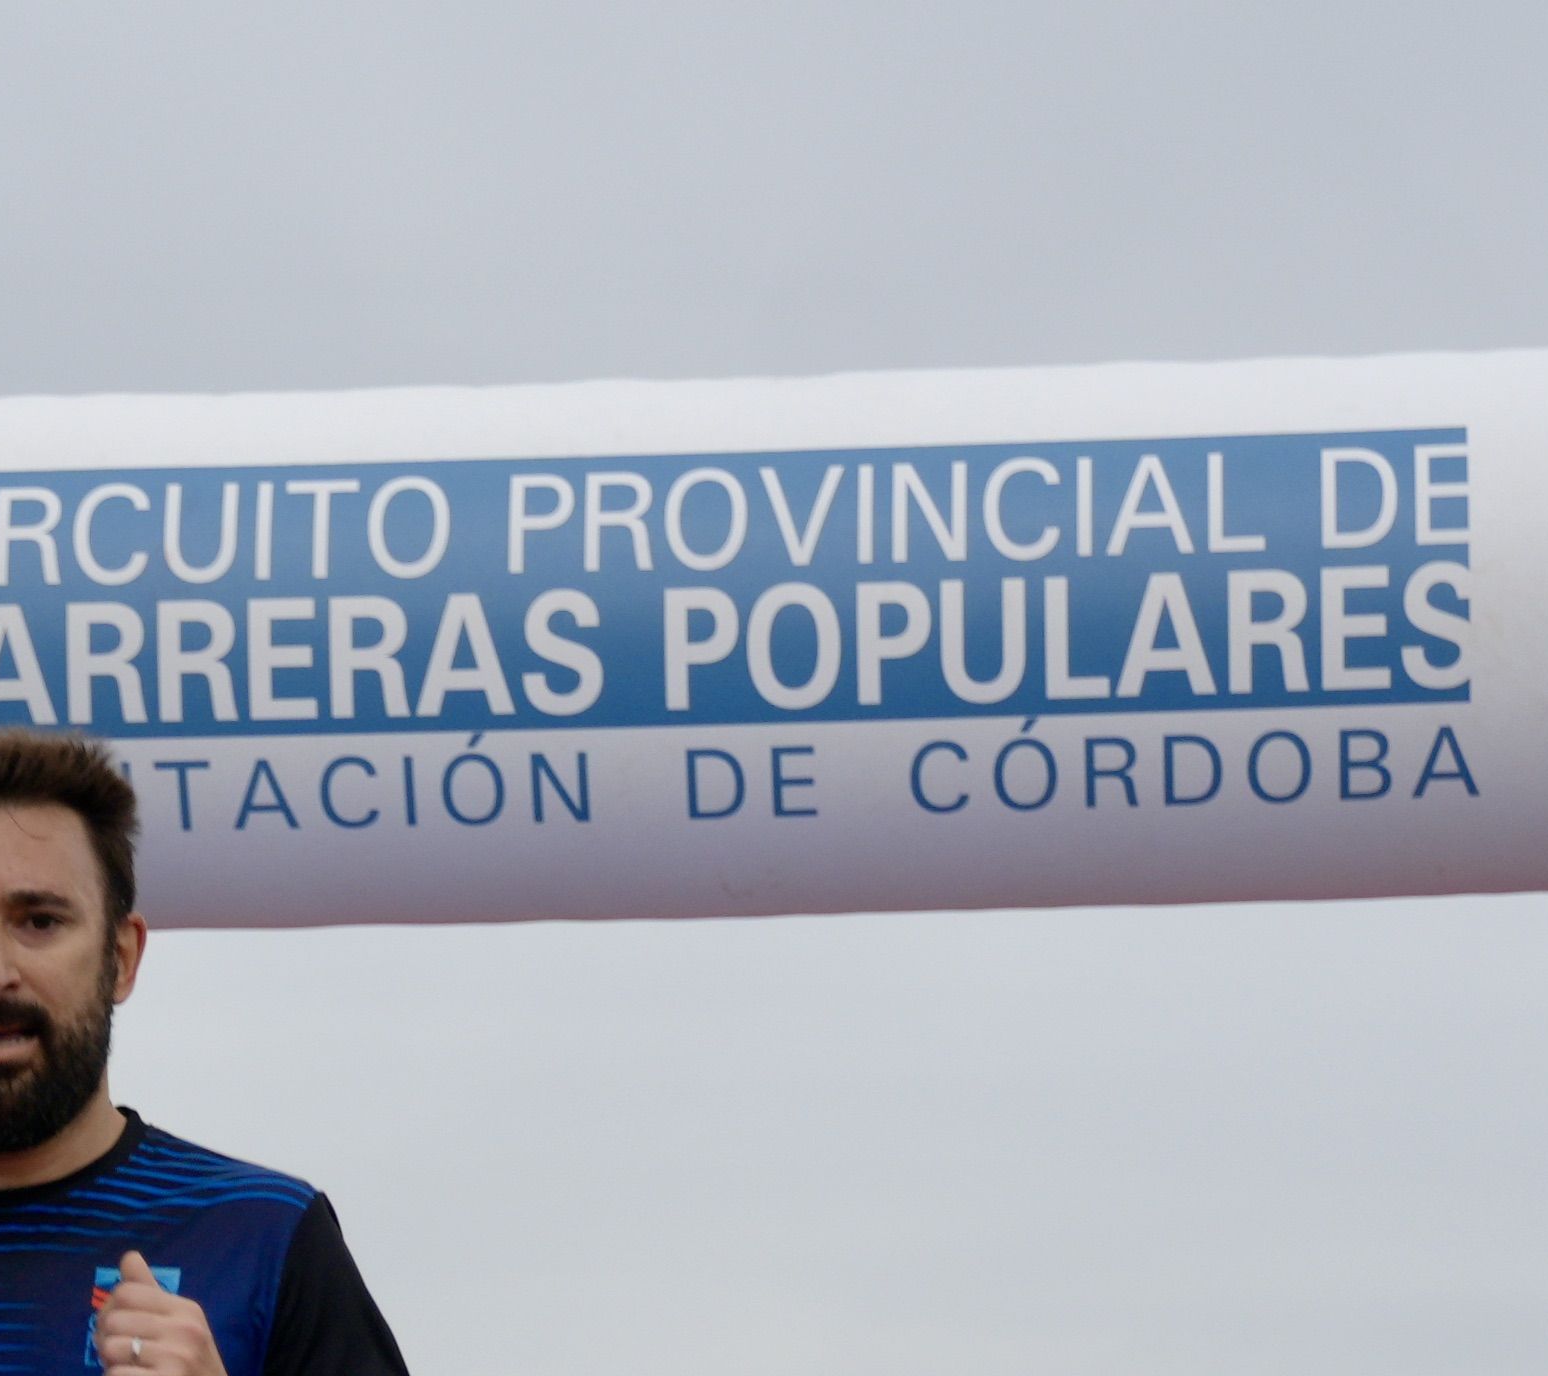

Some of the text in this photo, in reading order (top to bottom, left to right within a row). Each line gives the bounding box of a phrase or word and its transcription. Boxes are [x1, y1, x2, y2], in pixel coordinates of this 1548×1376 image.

[508, 451, 1266, 574] PROVINCIAL
[1320, 442, 1468, 550] DE
[663, 560, 1471, 711] POPULARES
[121, 718, 1480, 832] TACIÓN DE CÓRDOBA
